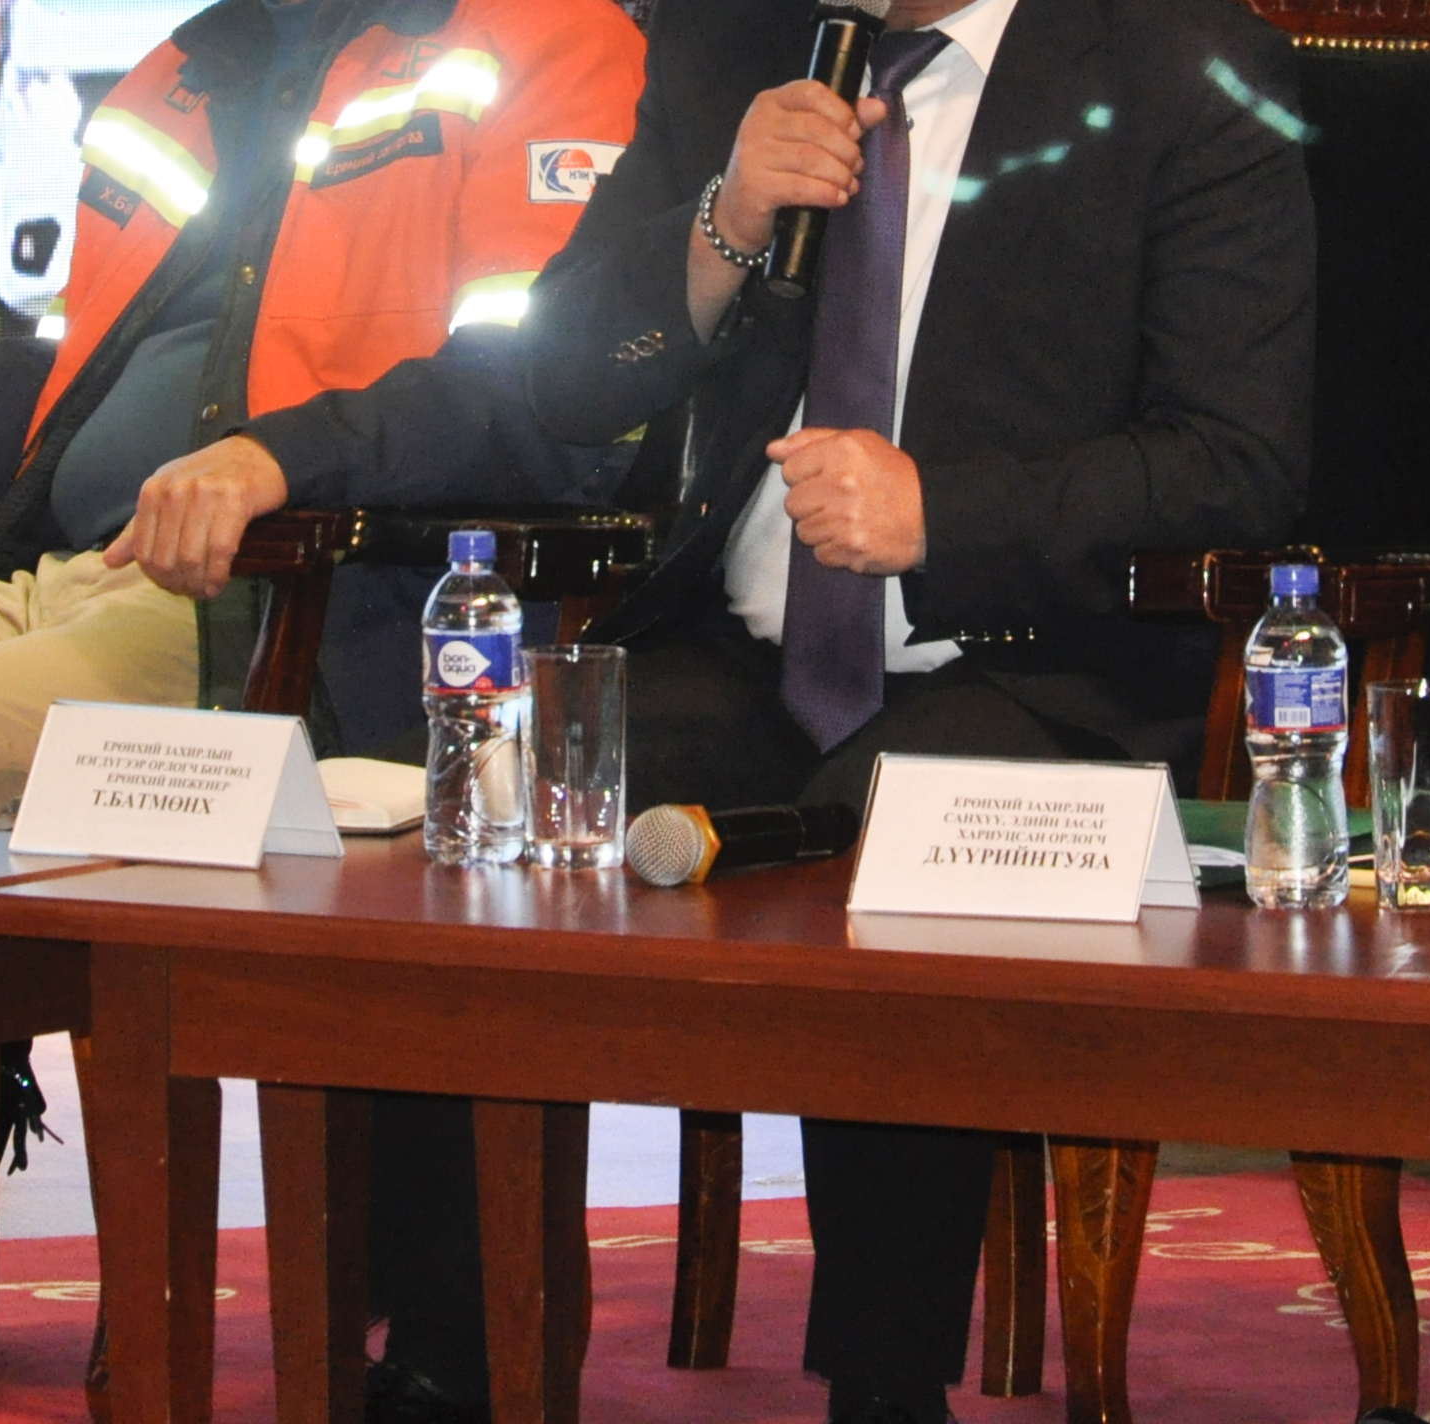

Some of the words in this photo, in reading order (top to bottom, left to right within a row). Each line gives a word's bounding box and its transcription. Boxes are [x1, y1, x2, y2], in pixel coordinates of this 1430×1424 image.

[443, 652, 471, 663] bon-
[443, 664, 476, 675] aqua
[92, 789, 214, 814] Т.БАТМӨНХ
[953, 796, 1023, 811] ЕРӨНХИЙ
[1027, 800, 1105, 814] ЗАХИРЛЫН
[1063, 817, 1107, 830] ЗАСАГ
[1048, 833, 1107, 846] ОРЛОГЧ
